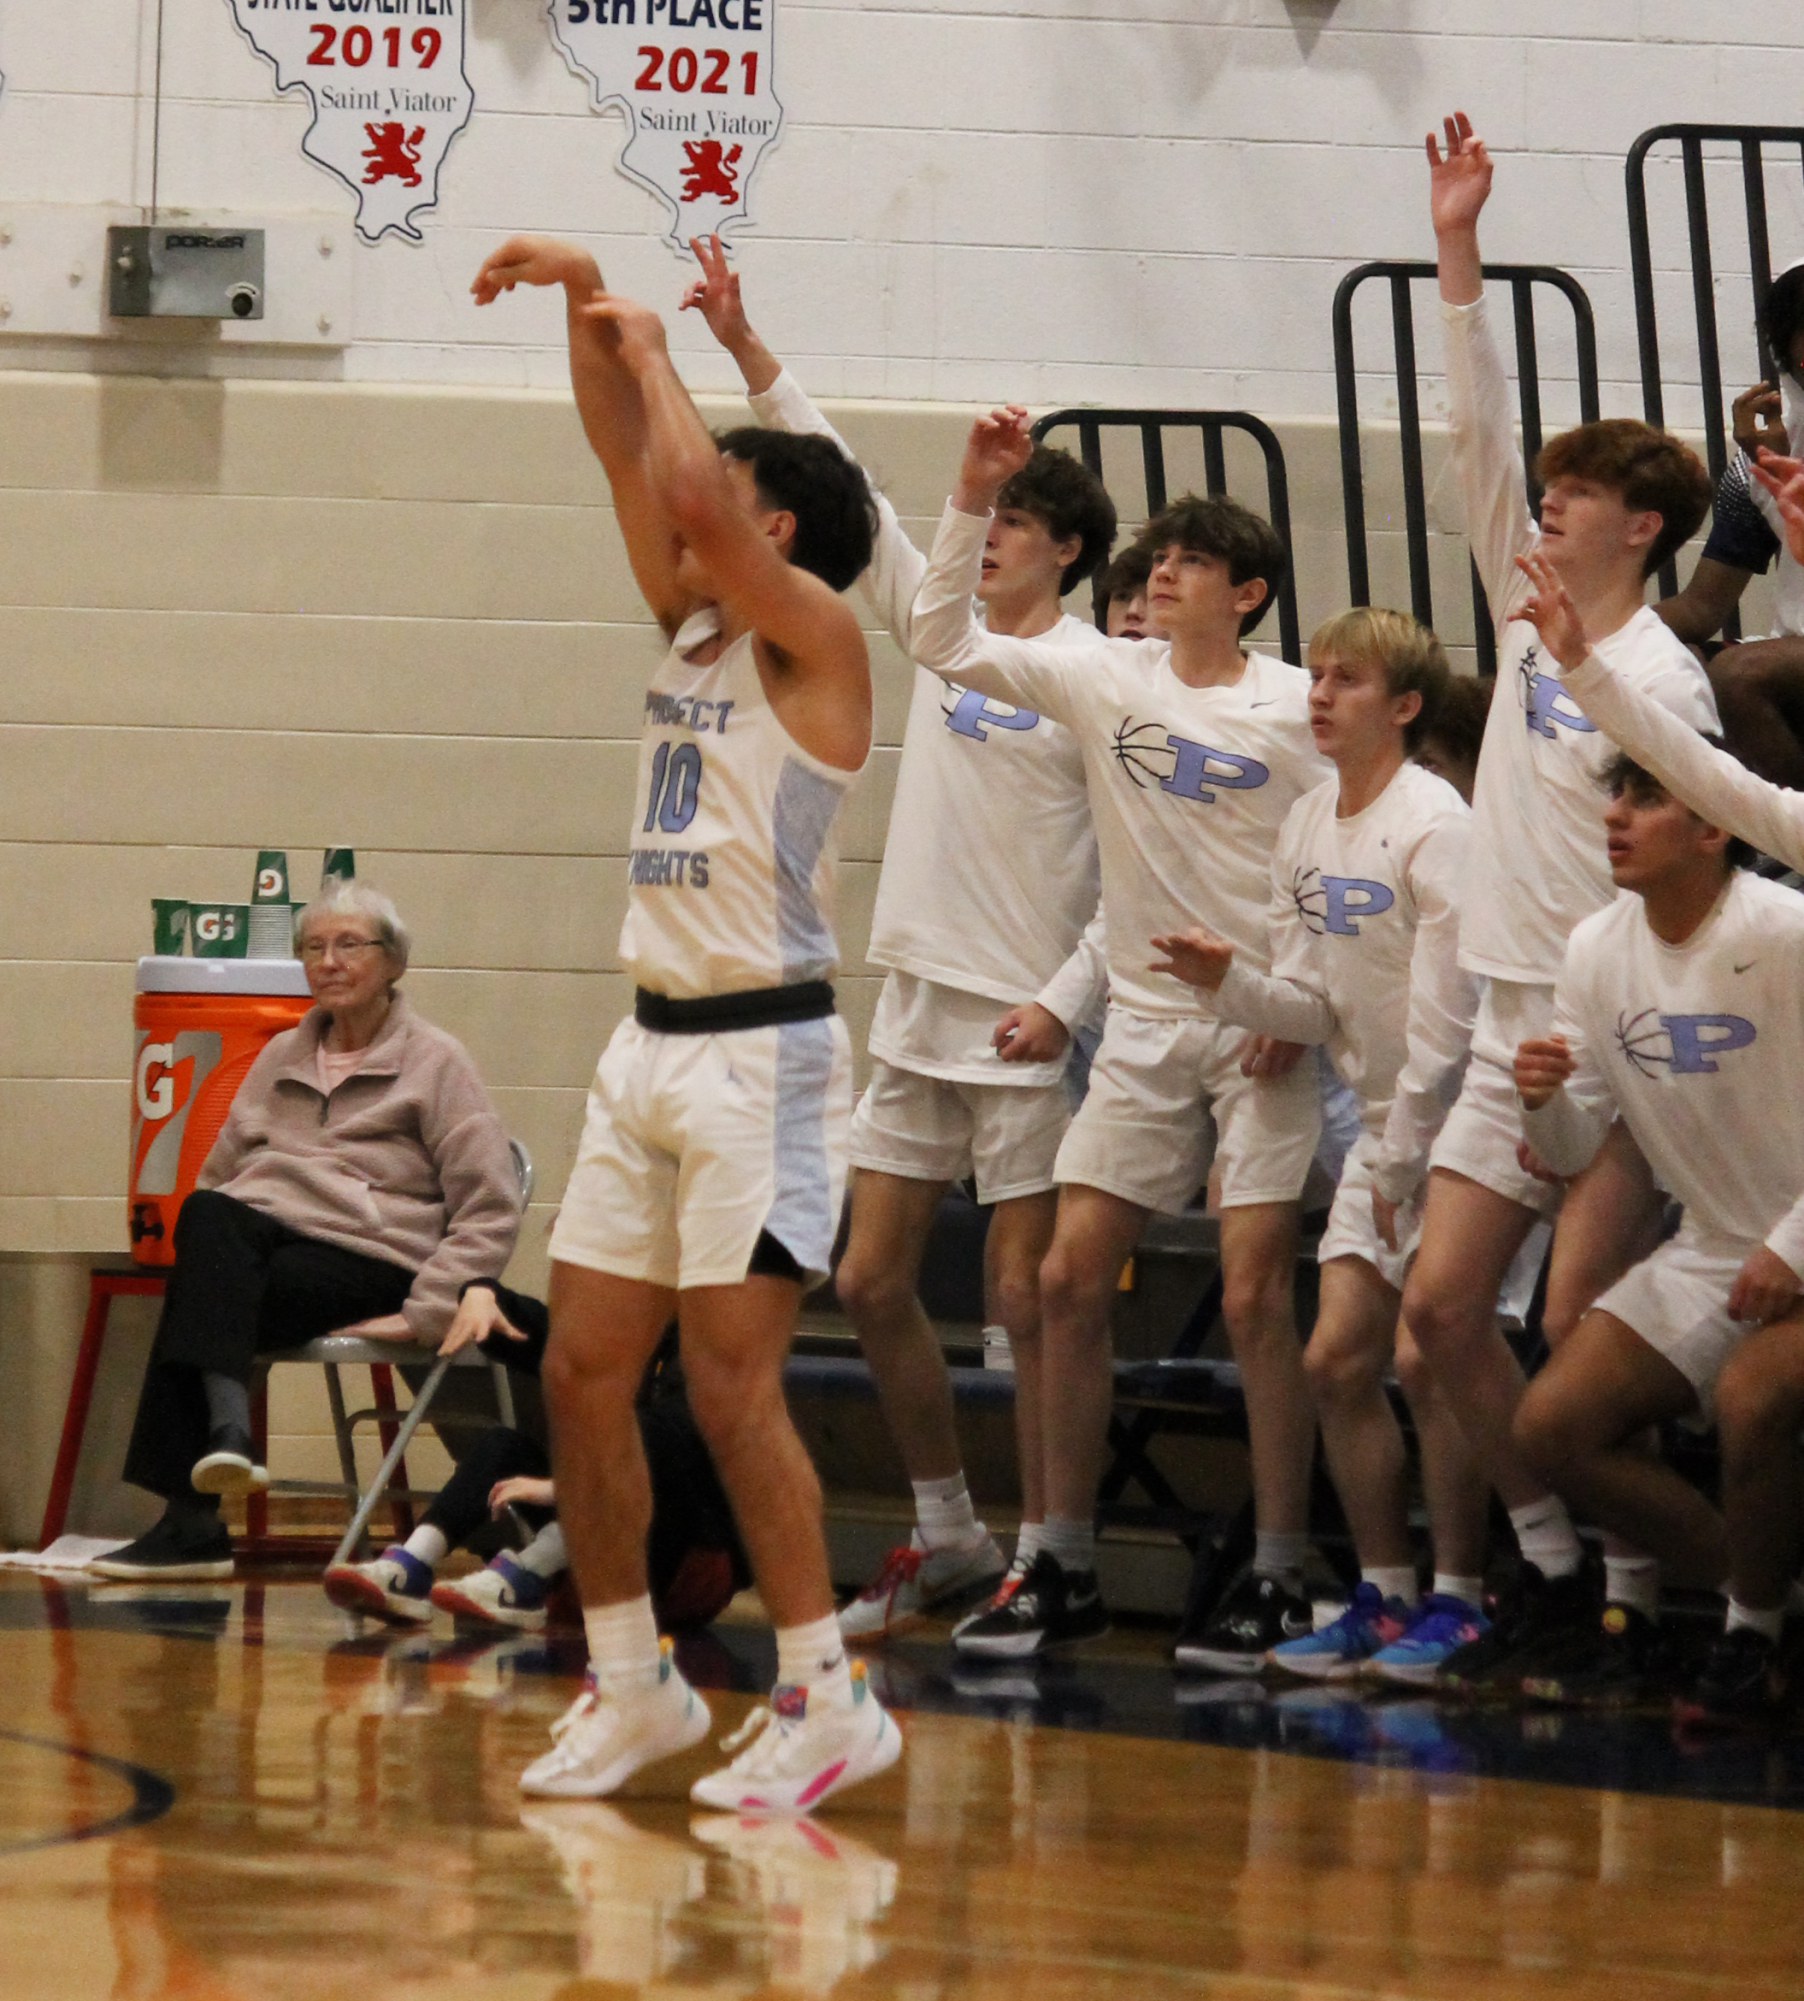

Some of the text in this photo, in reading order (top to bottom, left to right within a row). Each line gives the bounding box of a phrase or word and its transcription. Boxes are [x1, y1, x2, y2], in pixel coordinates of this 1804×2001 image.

[567, 0, 762, 30] 5th PLACE
[307, 23, 441, 69] 2019
[635, 46, 758, 95] 2021
[320, 85, 458, 113] Saint Viator
[639, 106, 773, 136] Saint Viator
[643, 741, 702, 833] 10
[1159, 734, 1270, 803] P
[630, 849, 709, 888] NIGHTS
[1320, 875, 1395, 936] P
[1660, 1013, 1757, 1074] P
[137, 1042, 174, 1121] G
